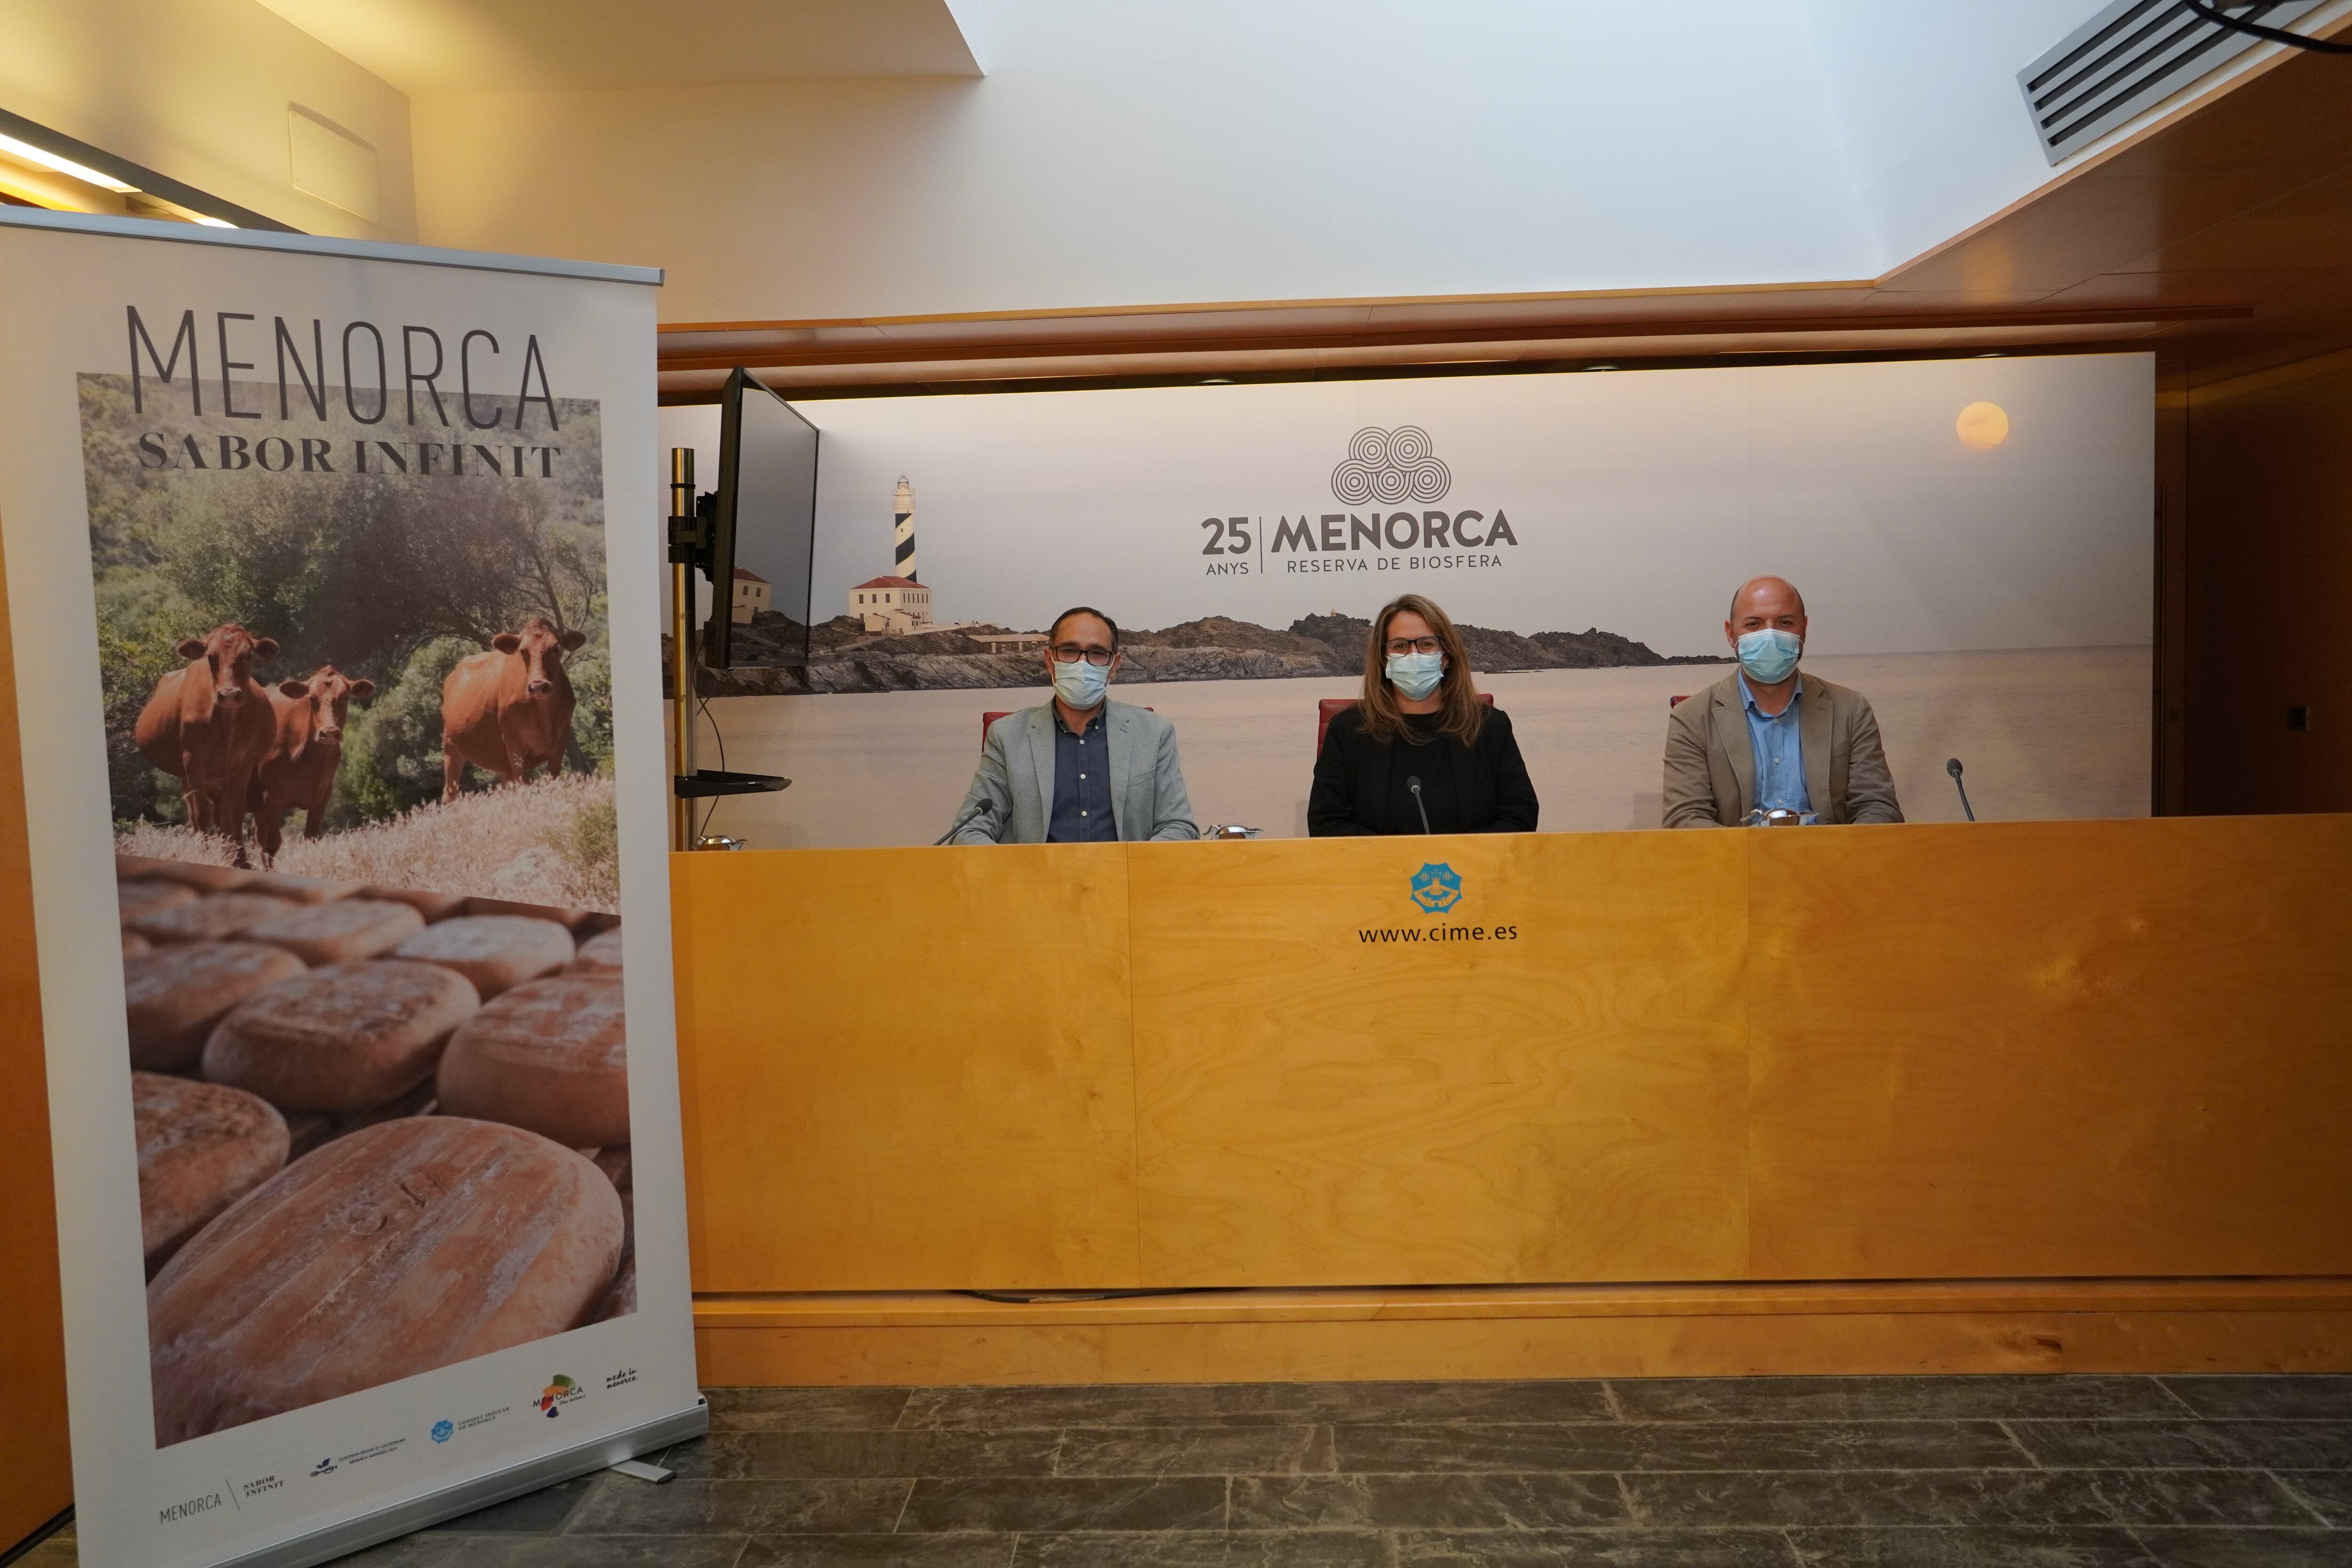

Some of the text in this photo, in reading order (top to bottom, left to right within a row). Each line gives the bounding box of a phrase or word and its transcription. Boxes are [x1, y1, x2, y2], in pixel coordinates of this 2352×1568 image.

[126, 304, 560, 432] MENORCA
[139, 432, 561, 479] SABOR INFINIT
[1200, 517, 1252, 555] 25
[1271, 509, 1518, 553] MENORCA
[1206, 562, 1249, 576] ANYS
[1287, 555, 1502, 573] RESERVA DE BIOSFERA
[1358, 923, 1517, 943] www.cime.es
[533, 1386, 583, 1408] MENORCA
[458, 1407, 509, 1426] CONSELL INSULAR
[468, 1416, 495, 1427] MENORCA
[244, 1475, 275, 1490] SABOR
[246, 1480, 285, 1497] INFINIT
[160, 1493, 222, 1525] MENORCA
